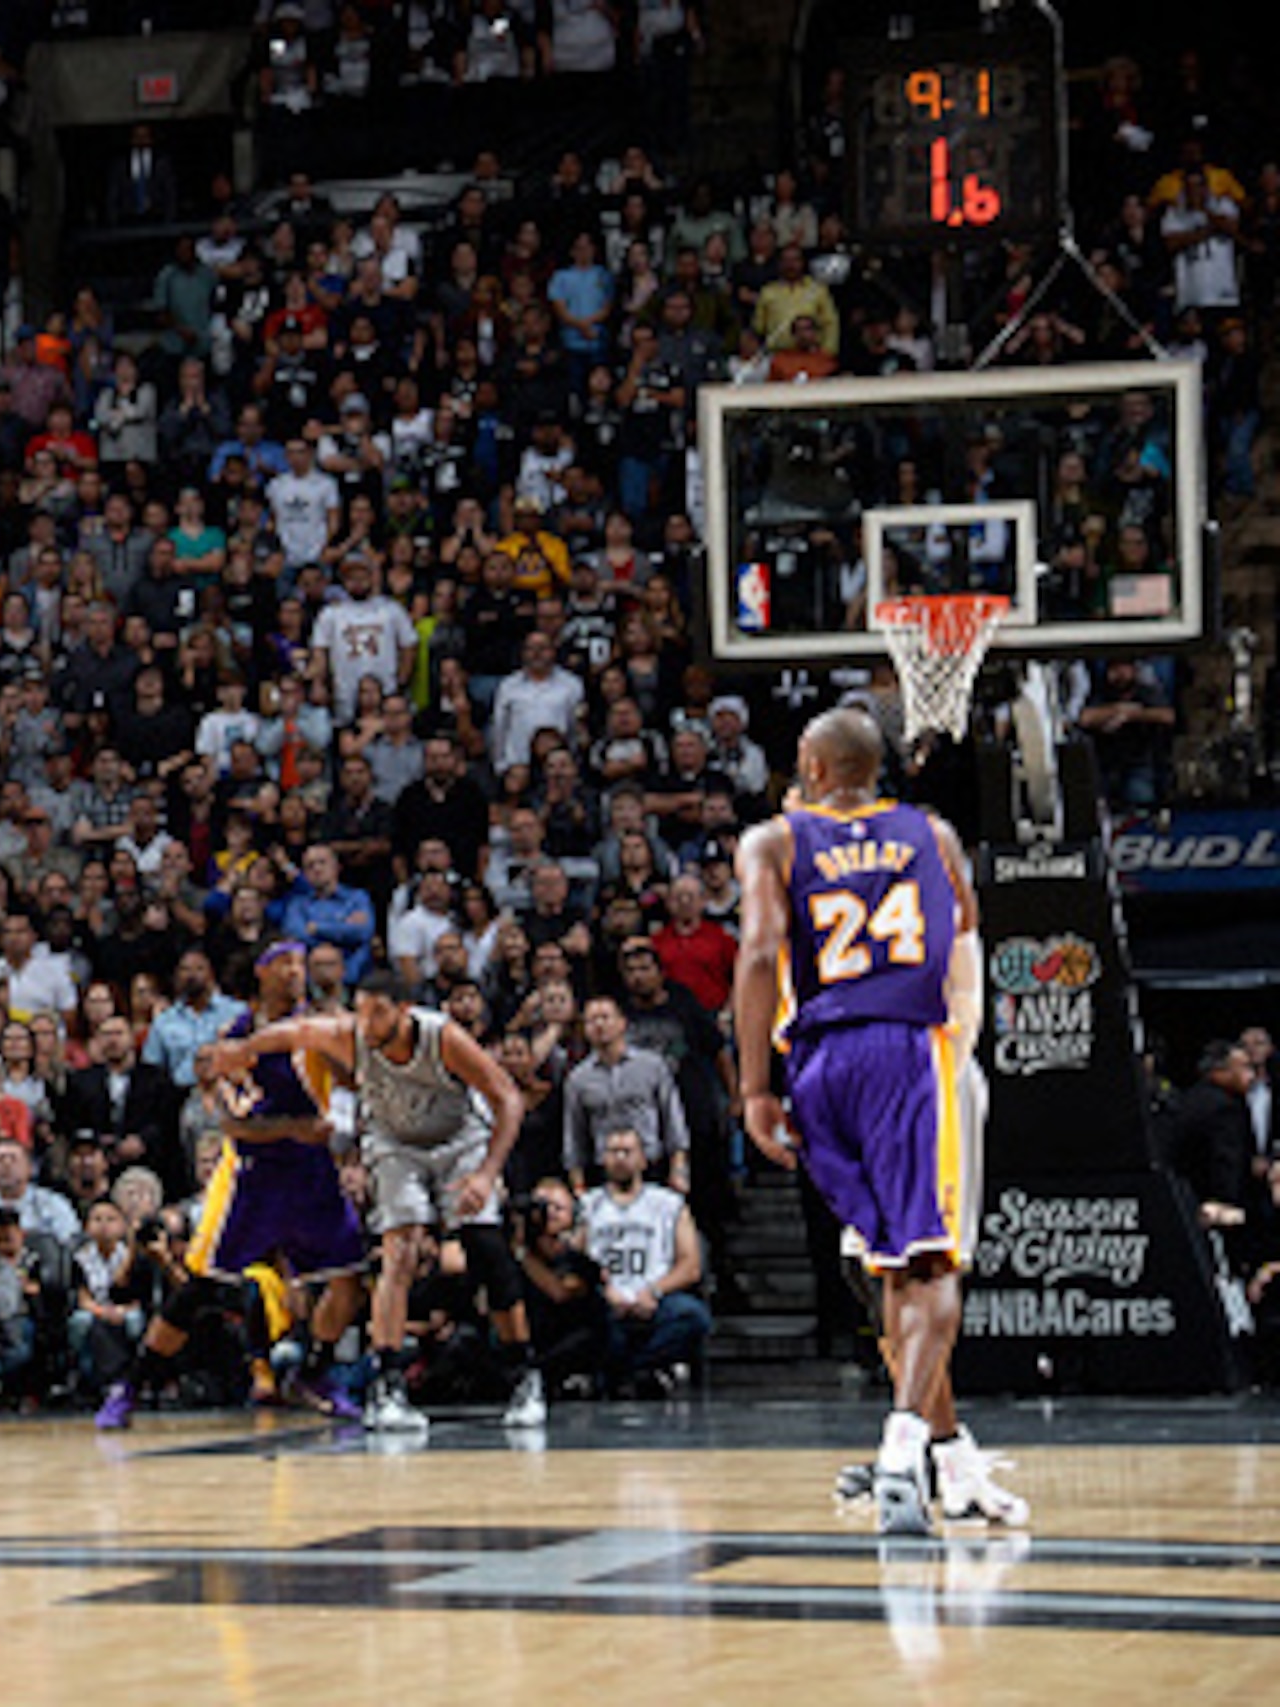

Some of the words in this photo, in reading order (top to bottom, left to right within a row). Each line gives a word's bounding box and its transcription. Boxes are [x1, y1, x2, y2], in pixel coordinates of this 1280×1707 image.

[1111, 833, 1241, 871] BUD
[808, 880, 926, 985] 24
[984, 1186, 1139, 1236] Season
[1011, 1230, 1150, 1287] Giving
[962, 1288, 1177, 1338] #NBACares
